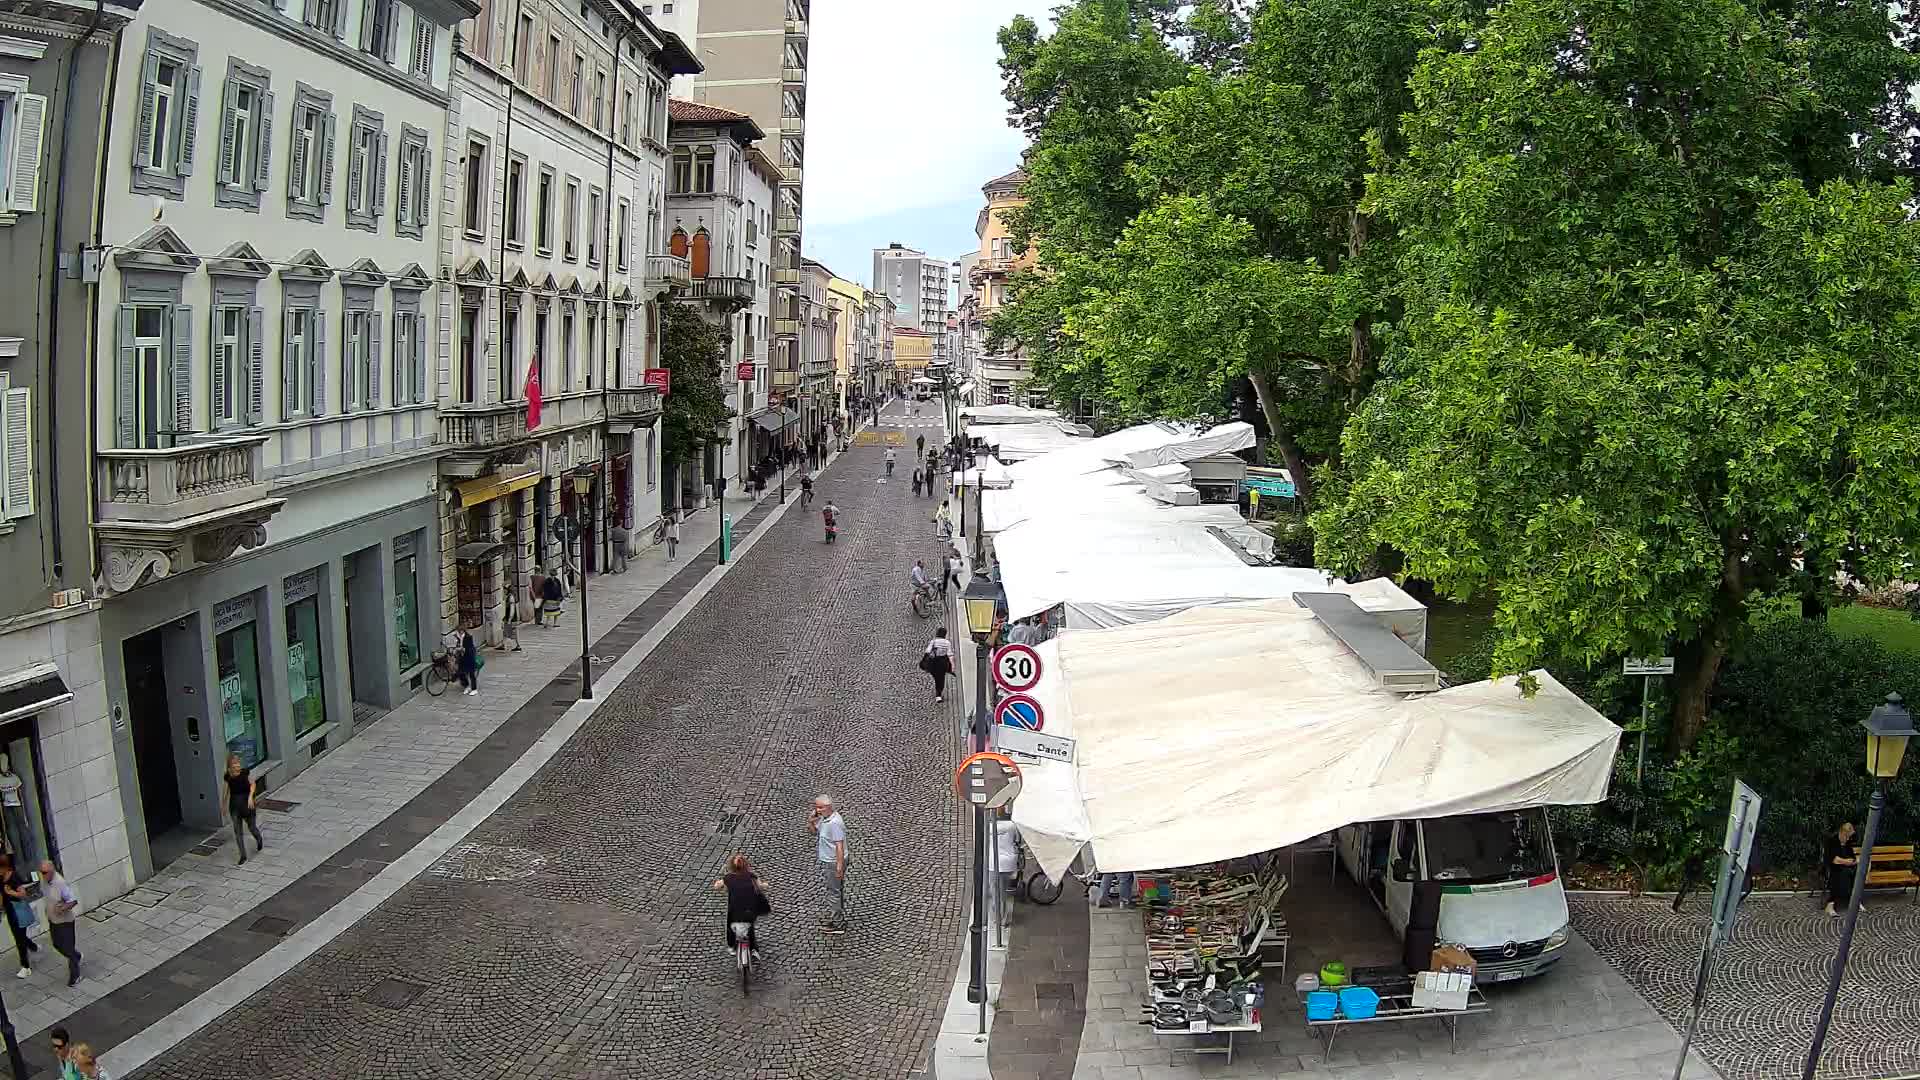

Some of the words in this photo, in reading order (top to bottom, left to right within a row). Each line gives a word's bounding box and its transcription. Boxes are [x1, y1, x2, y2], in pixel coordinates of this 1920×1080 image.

[1005, 657, 1031, 678] 30
[221, 678, 239, 701] 130
[1037, 743, 1067, 756] Dante
